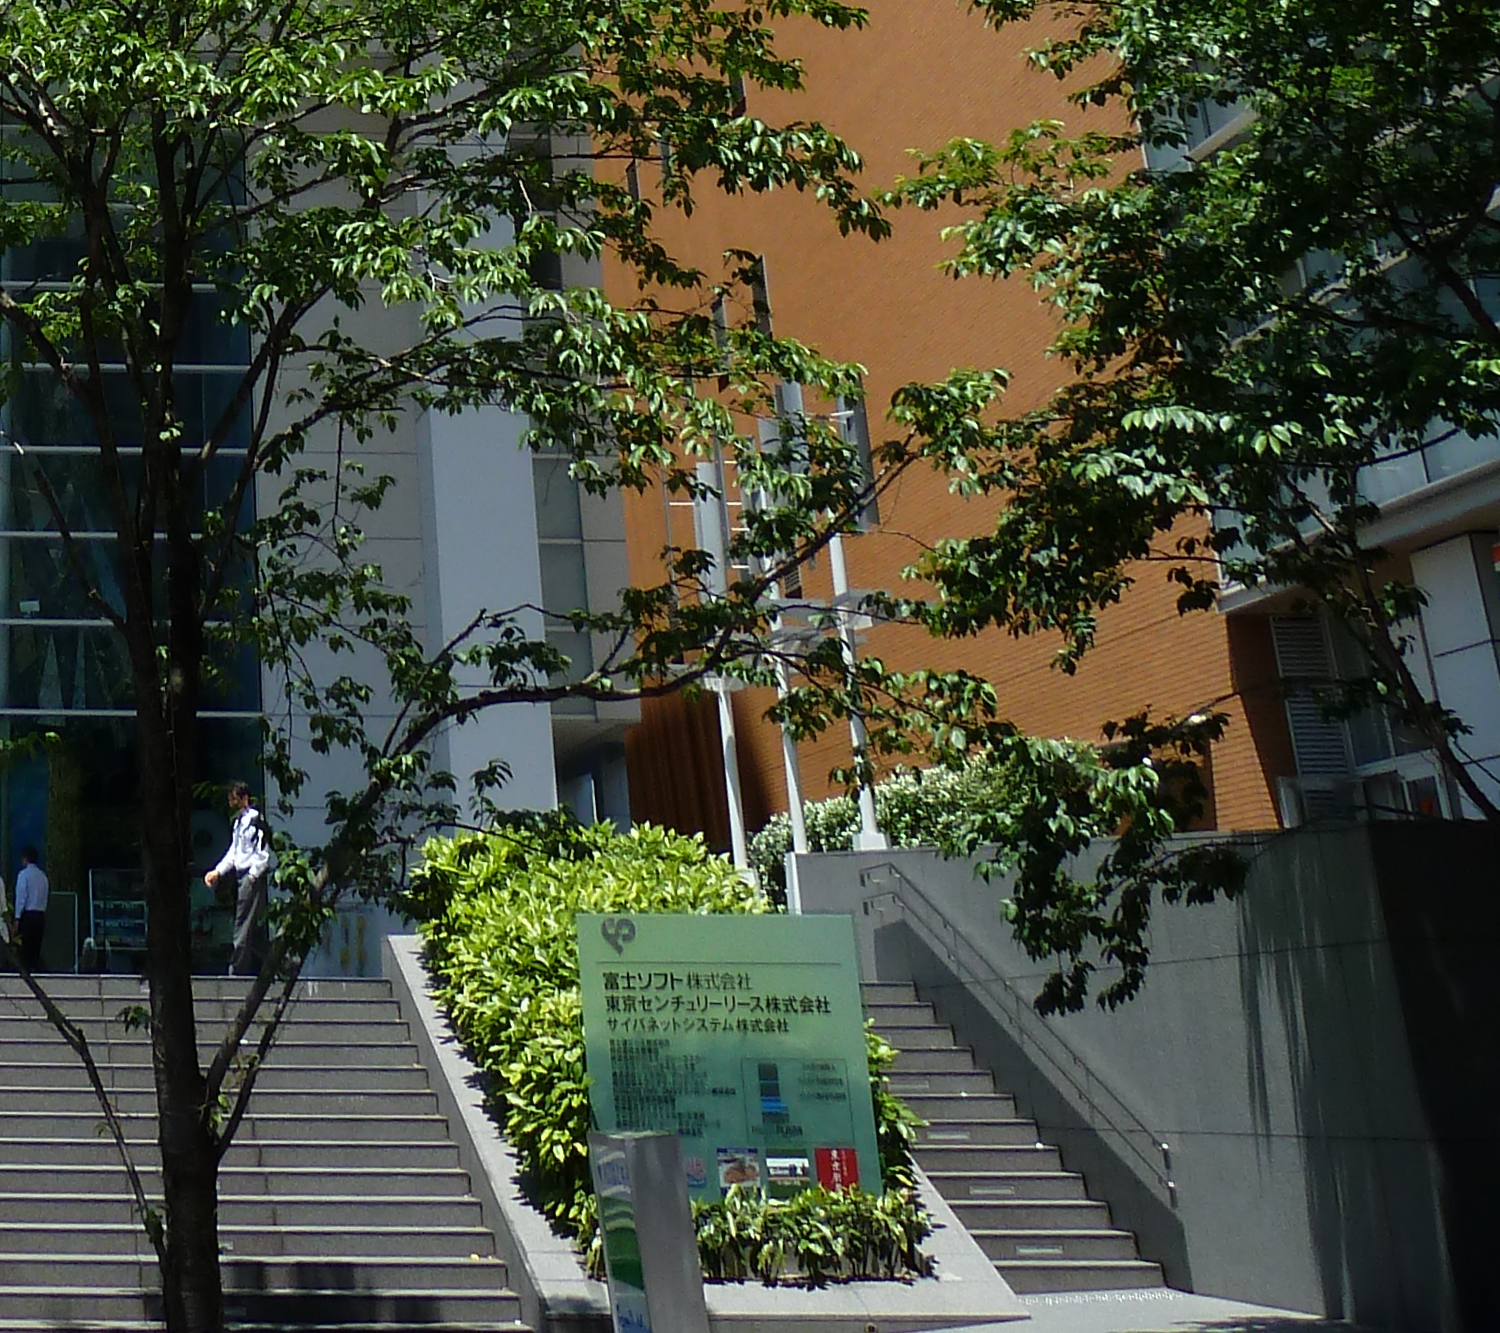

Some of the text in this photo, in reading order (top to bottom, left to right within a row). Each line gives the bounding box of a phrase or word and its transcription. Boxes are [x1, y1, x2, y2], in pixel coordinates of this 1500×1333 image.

[605, 994, 832, 1014] 東京センチュリーリース株式会社
[607, 1017, 790, 1034] サイバネットシステム株式会社
